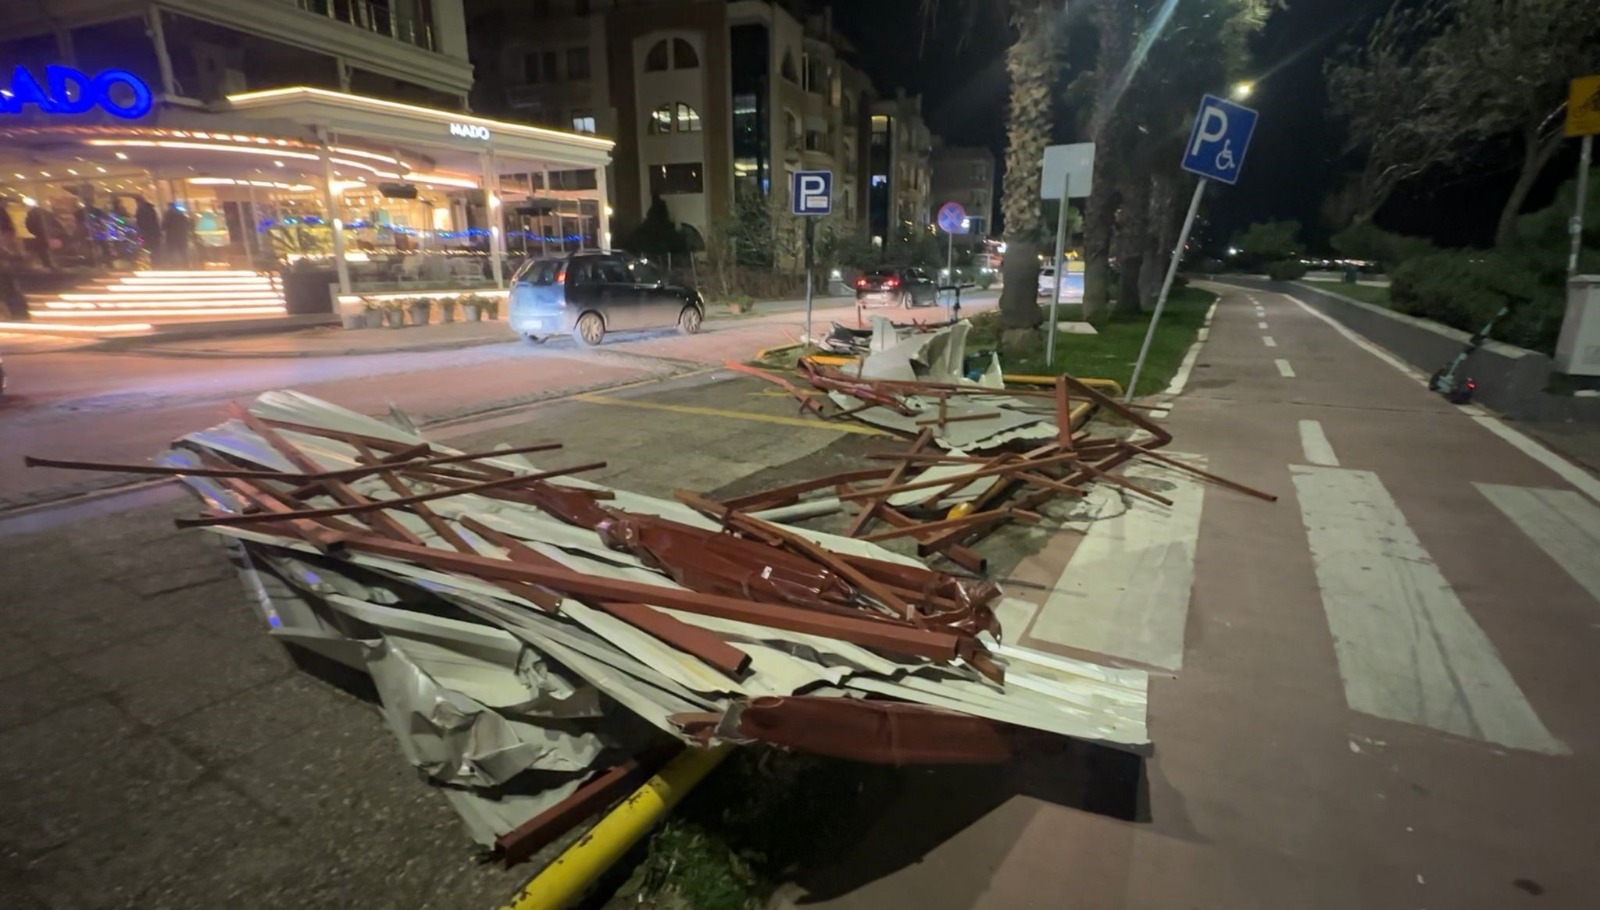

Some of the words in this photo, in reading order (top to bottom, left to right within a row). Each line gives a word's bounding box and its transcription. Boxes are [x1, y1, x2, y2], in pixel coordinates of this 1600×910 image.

[0, 63, 153, 120] ADO
[450, 122, 490, 141] MADO
[1191, 105, 1228, 156] P
[799, 175, 826, 212] P
